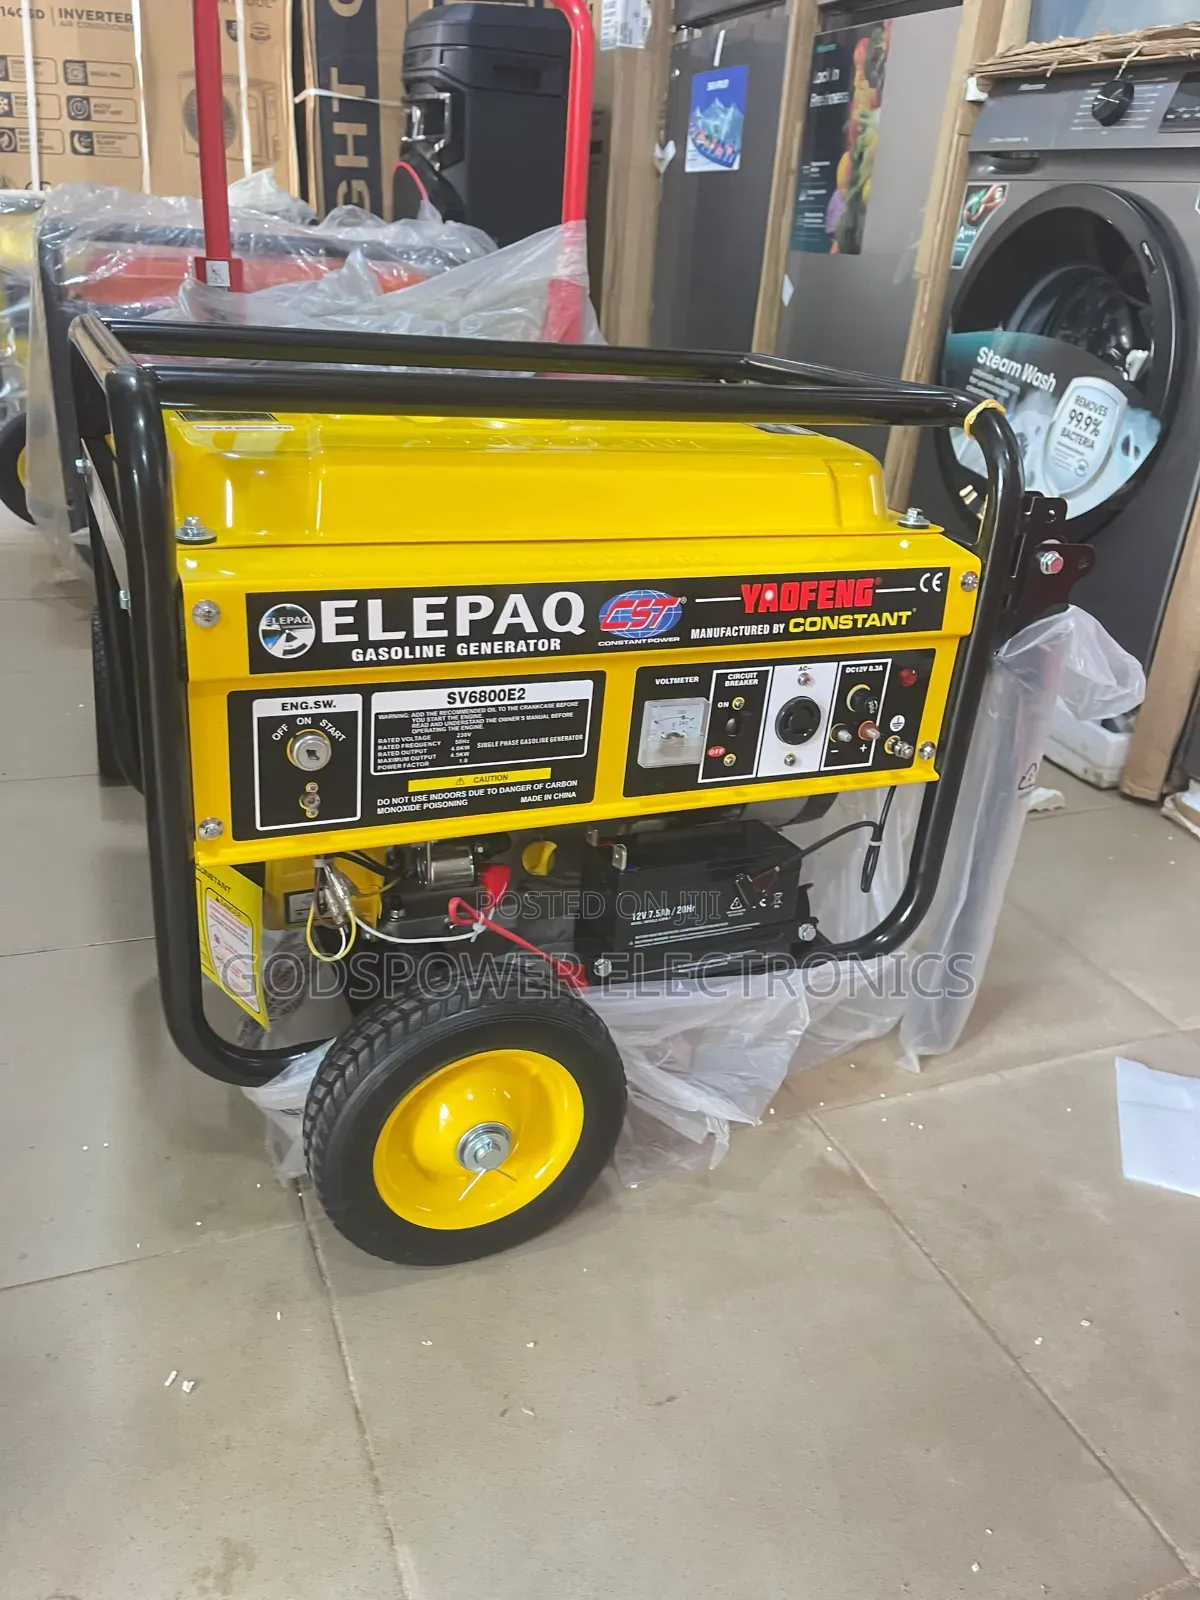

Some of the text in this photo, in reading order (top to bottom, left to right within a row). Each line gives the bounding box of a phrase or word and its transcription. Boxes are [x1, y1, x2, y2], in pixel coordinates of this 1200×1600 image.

[58, 8, 133, 23] INVERTER
[977, 347, 1021, 378] Steam
[1022, 362, 1057, 393] Wash
[1075, 395, 1109, 417] REMOVES
[1068, 409, 1103, 437] 99.9%
[1060, 427, 1095, 450] BACTERIA
[741, 578, 875, 613] YAOFENG
[264, 615, 312, 625] ELEPAQ
[320, 591, 586, 643] ELEPAQ
[600, 597, 682, 631] CST
[691, 611, 912, 640] MANUFACTURED BY CONSTANT
[598, 636, 680, 647] CONSTANT POWER
[351, 638, 562, 662] GASOLINE GENERATOR
[727, 672, 758, 680] CIRCUIT
[845, 664, 883, 673] DC12V 8.3A
[655, 676, 699, 685] VOLTMETER
[725, 679, 759, 687] BREAKER
[447, 688, 526, 705] SV6800E2
[281, 699, 337, 711] ENG.SW.
[439, 707, 487, 716] RECOMMENDED
[272, 717, 347, 742] OFF ON START
[411, 726, 447, 734] OPERATING
[444, 718, 484, 727] UNDERSTAND
[401, 741, 441, 749] FREQUENCY
[477, 741, 499, 749] SINGLE
[499, 739, 519, 747] PHASE
[520, 737, 549, 745] GASOLINE
[549, 734, 583, 743] GENERATOR
[708, 747, 726, 756] OFF
[473, 774, 508, 784] CAUTION
[377, 798, 390, 806] DO
[392, 796, 410, 804] NOT
[411, 794, 428, 802] USE
[429, 790, 467, 800] INDOORS
[487, 787, 498, 795] TO
[499, 784, 532, 793] DANGER
[533, 782, 544, 790] OF
[545, 779, 578, 789] CARBON
[377, 804, 422, 814] MONOXIDE
[423, 799, 468, 810] POISONING
[520, 794, 543, 803] MADE
[553, 791, 577, 799] CHINA
[632, 911, 647, 921] 12V
[648, 908, 671, 919] 7.5Ah
[676, 904, 696, 914] 20Hr
